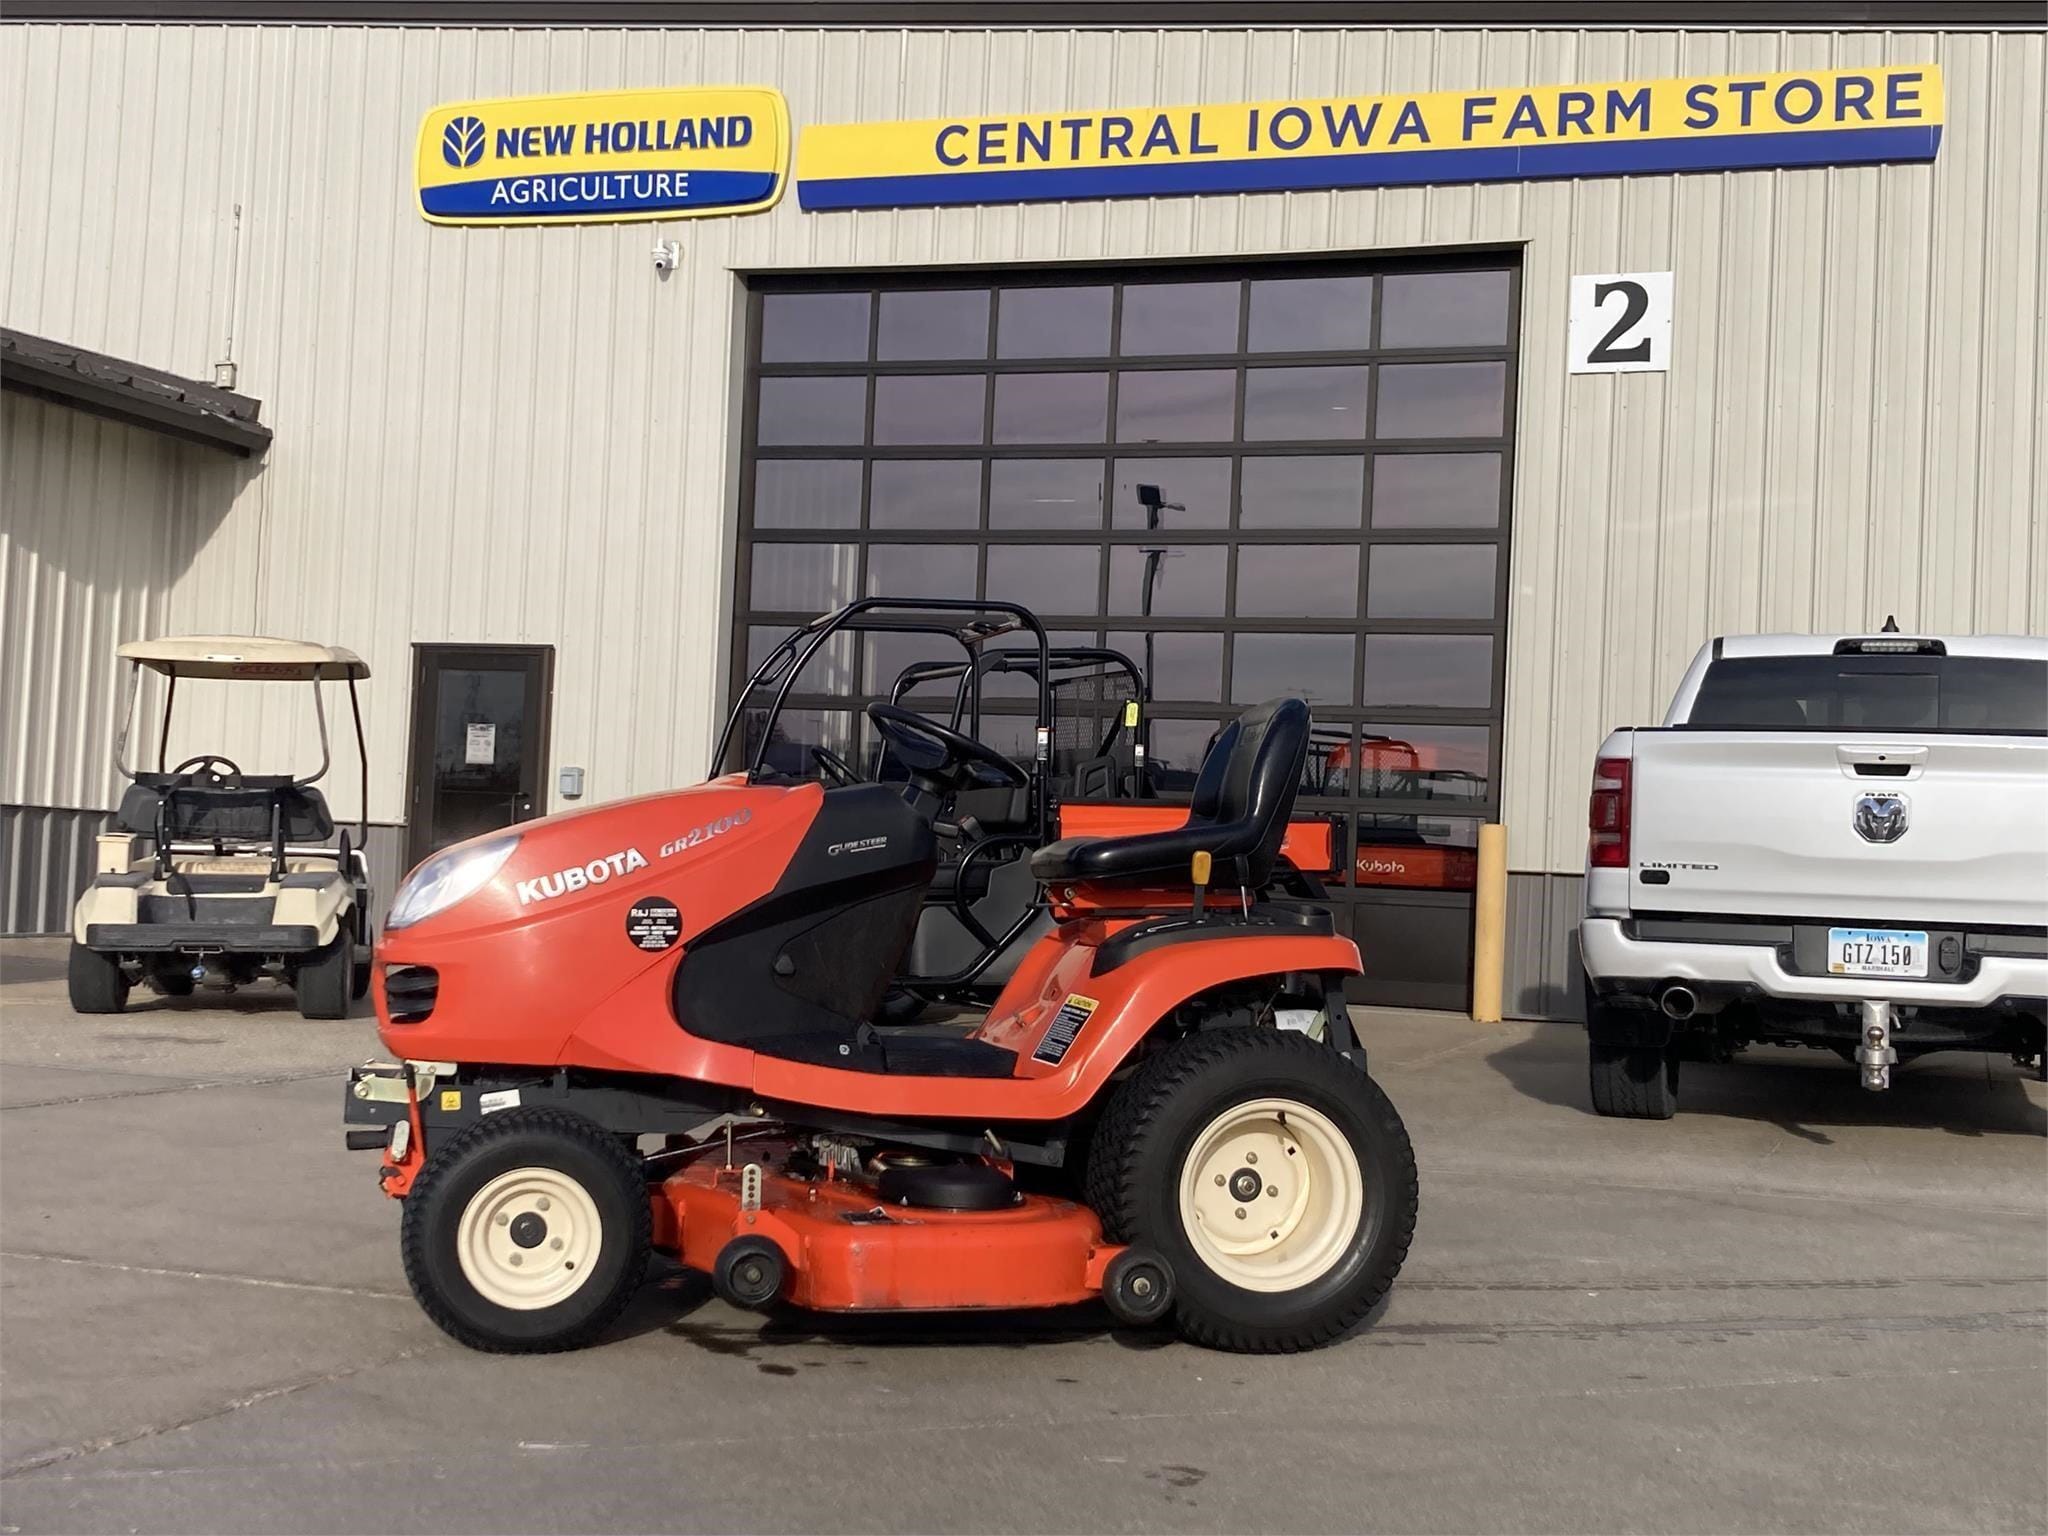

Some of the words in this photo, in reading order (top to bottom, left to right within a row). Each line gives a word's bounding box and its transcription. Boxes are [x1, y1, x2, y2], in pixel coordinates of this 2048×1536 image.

[497, 125, 574, 157] NEW
[585, 116, 754, 153] HOLLAND
[936, 110, 1218, 165] CENTRAL
[1248, 102, 1429, 152] IOWA
[1463, 88, 1651, 141] FARM
[1683, 72, 1924, 129] STORE
[490, 172, 690, 205] AGRICULTURE
[1586, 280, 1652, 364] 2
[659, 808, 753, 858] GR2100
[516, 848, 649, 905] KUBOTA
[1357, 859, 1405, 872] Kubota
[1640, 862, 1719, 870] LIMITED
[1843, 943, 1873, 964] GTZ
[1881, 944, 1912, 966] 150
